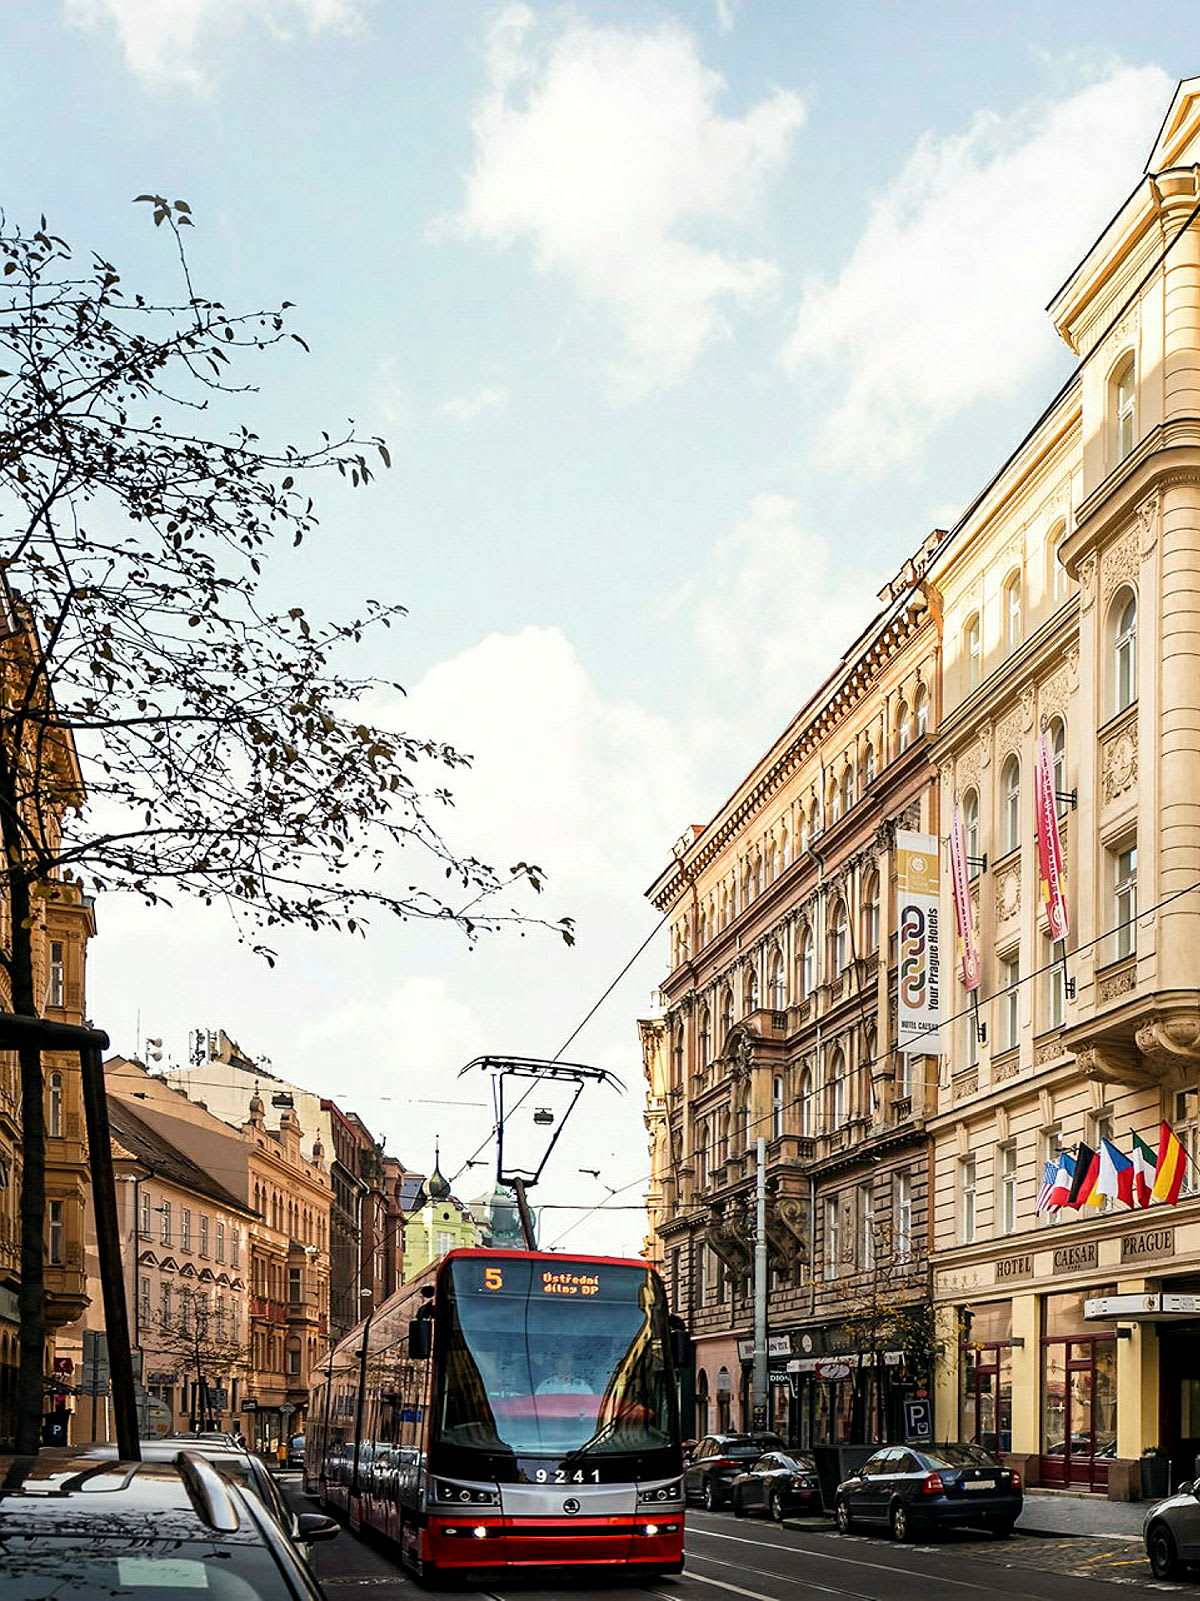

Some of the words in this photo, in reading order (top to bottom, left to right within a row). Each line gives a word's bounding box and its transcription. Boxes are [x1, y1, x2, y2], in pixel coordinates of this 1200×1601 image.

[927, 907, 939, 944] Hotels
[928, 945, 940, 985] Prague
[928, 985, 939, 1011] Your
[996, 1256, 1032, 1277] HOTEL
[1053, 1245, 1095, 1267] CAESAR
[1122, 1230, 1172, 1255] PRAGUE
[485, 1268, 503, 1290] 5
[581, 1285, 599, 1295] DP
[910, 1405, 925, 1427] P
[53, 1425, 62, 1435] P
[535, 1468, 600, 1483] 9241
